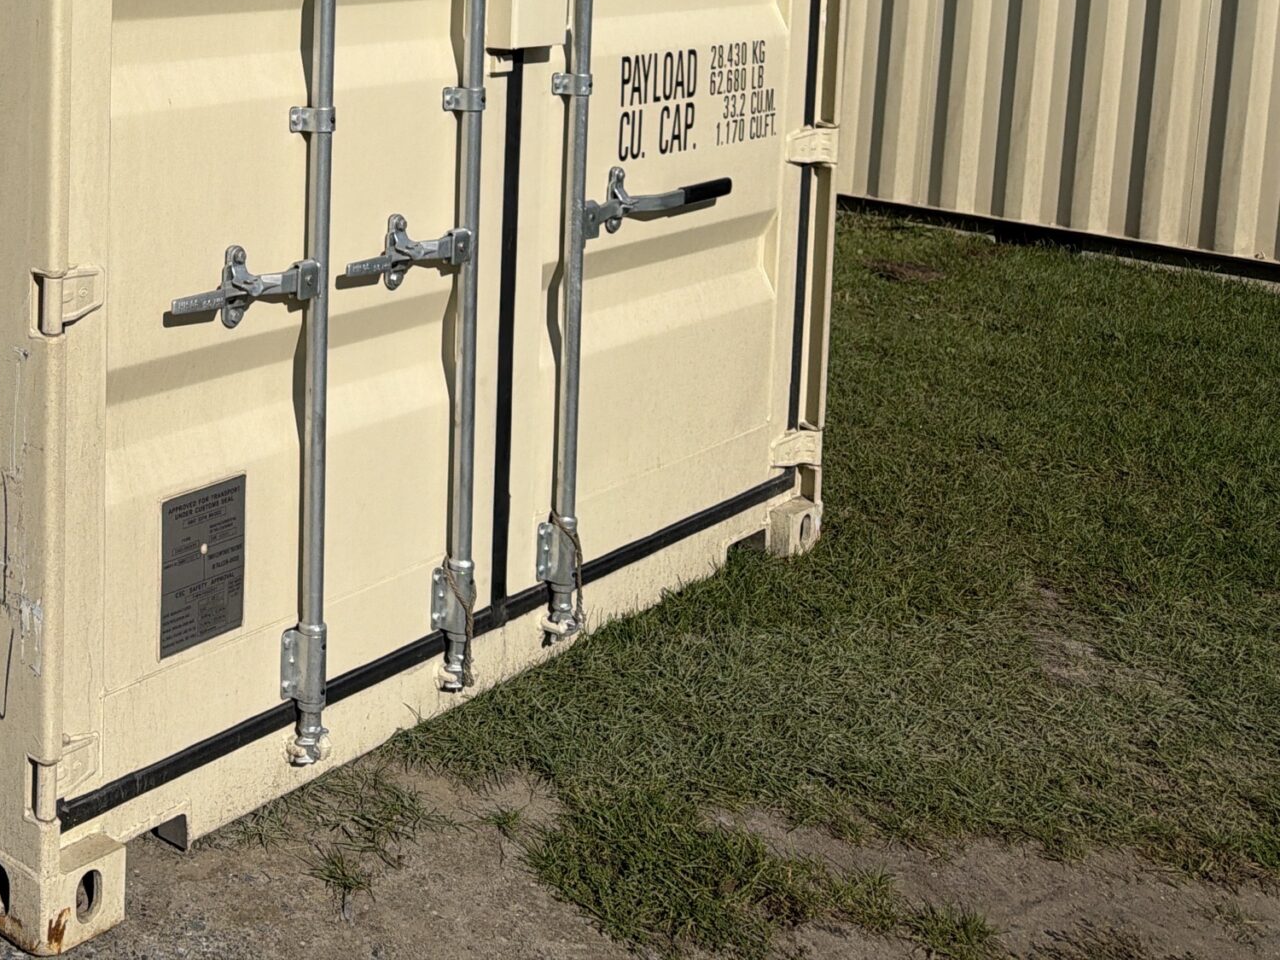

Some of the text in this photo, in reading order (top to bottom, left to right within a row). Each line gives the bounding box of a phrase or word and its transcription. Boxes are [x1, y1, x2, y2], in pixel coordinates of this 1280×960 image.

[710, 40, 766, 70] 28.430 KG
[621, 48, 698, 107] PAYLOAD
[709, 66, 764, 96] 62.680 LB
[723, 88, 776, 119] 33.2 CU.M.
[618, 102, 696, 162] CU. CAP.
[716, 118, 744, 146] 1.170
